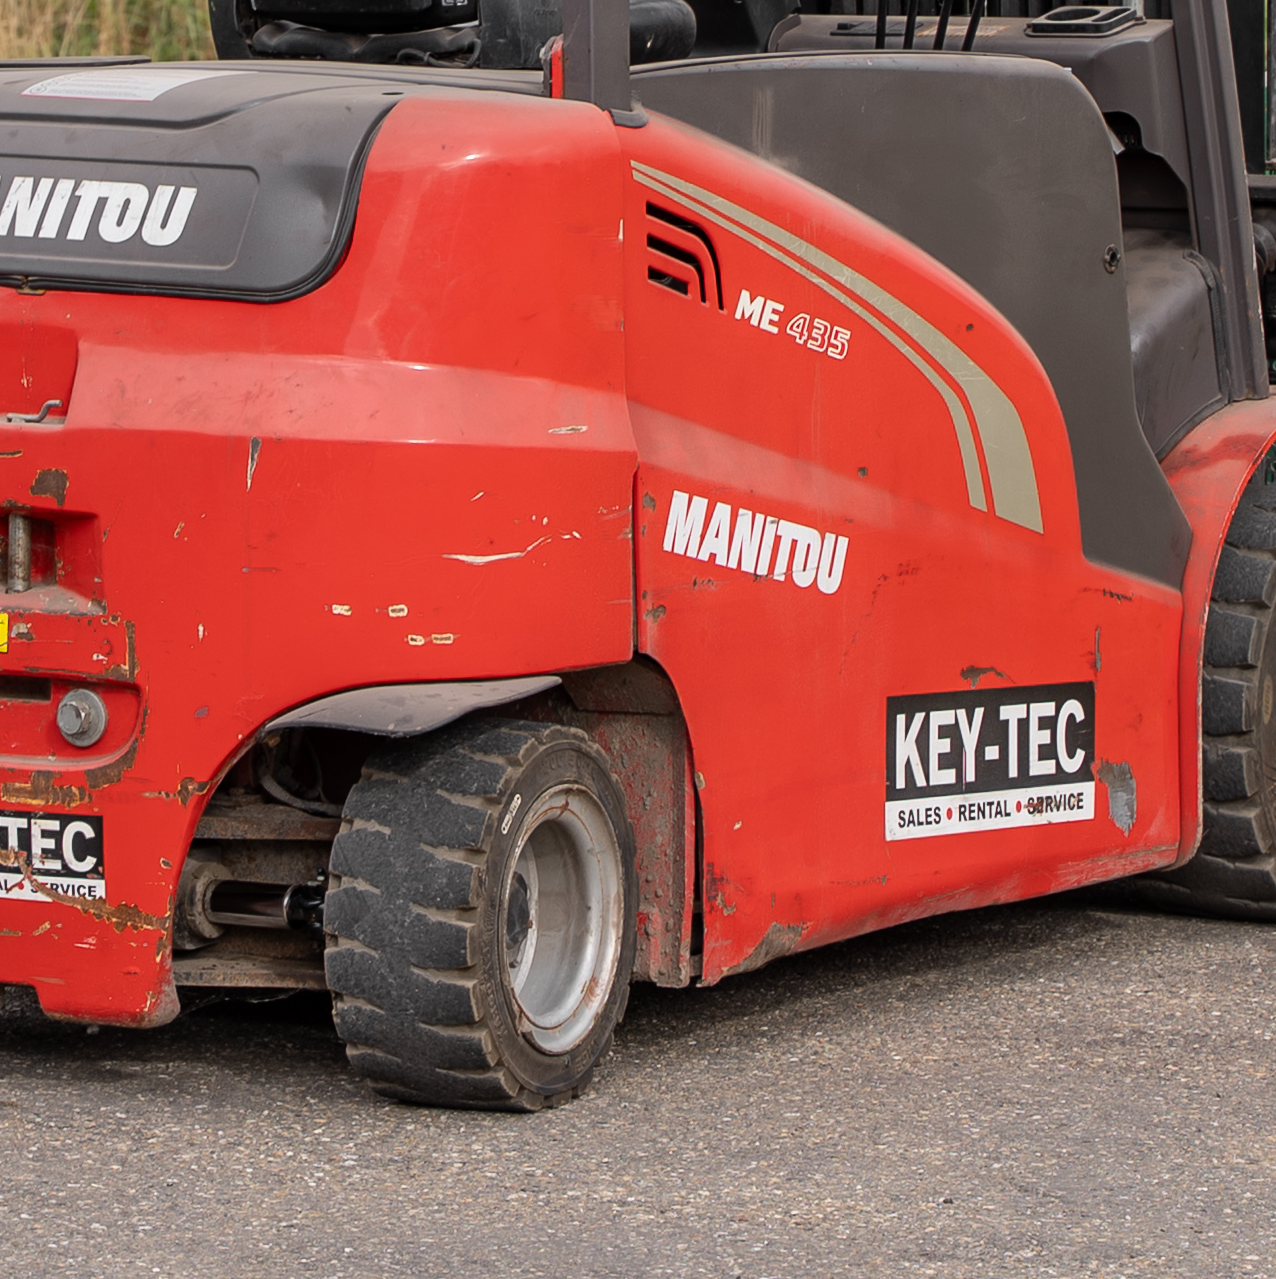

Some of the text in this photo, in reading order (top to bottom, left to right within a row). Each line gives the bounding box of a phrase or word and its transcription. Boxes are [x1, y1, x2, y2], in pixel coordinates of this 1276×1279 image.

[734, 288, 851, 360] ME 435
[662, 490, 849, 595] MANITOU
[895, 698, 1086, 790] KEY-TEC
[898, 792, 1084, 828] SALES RENTAL SERVICE
